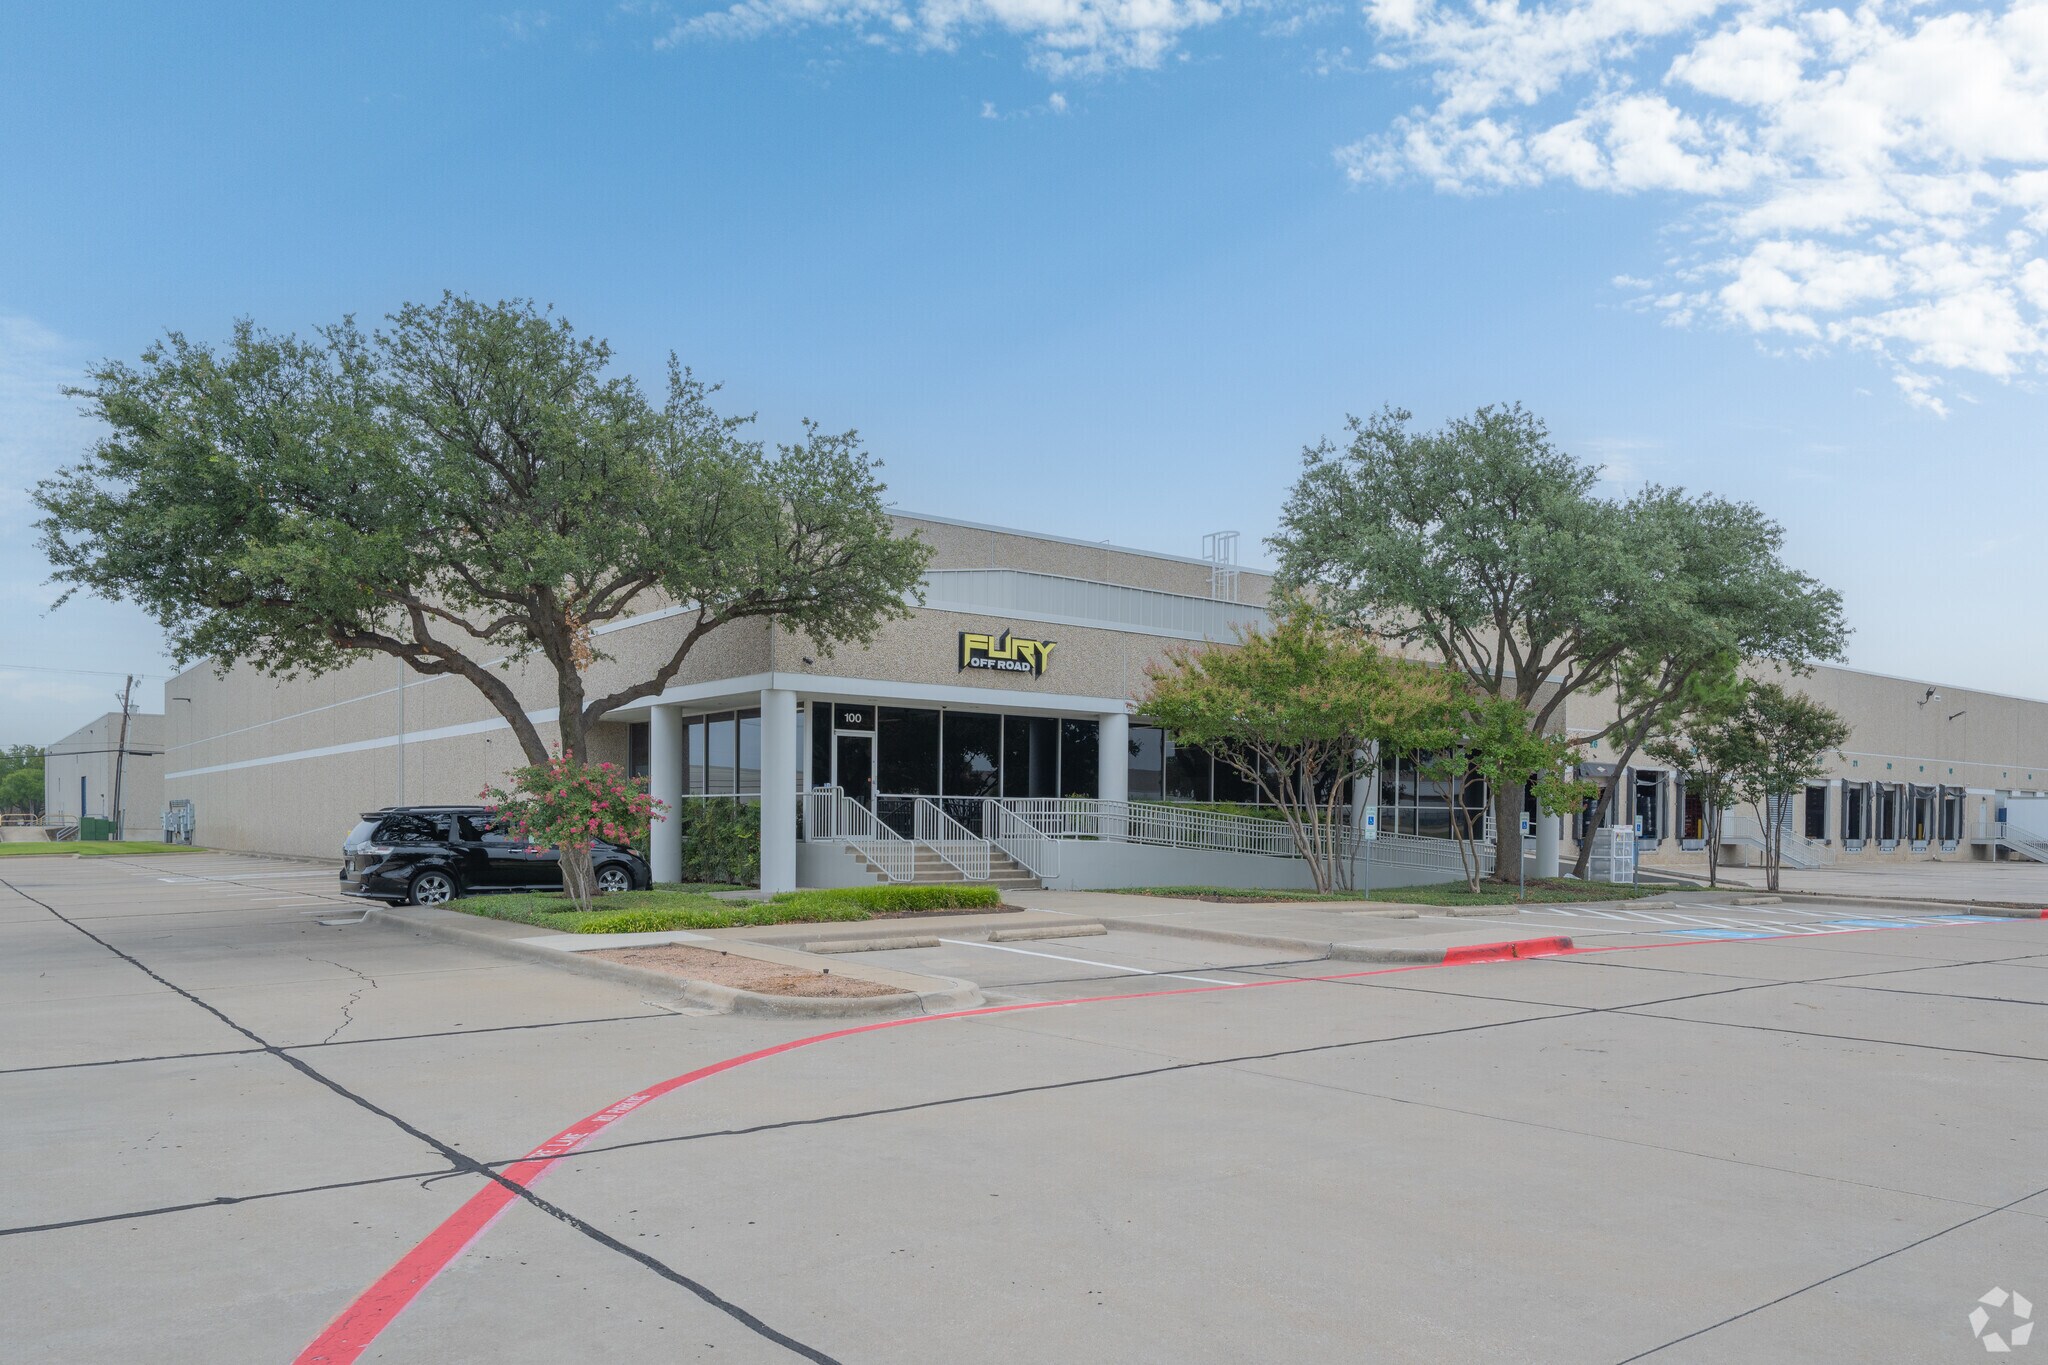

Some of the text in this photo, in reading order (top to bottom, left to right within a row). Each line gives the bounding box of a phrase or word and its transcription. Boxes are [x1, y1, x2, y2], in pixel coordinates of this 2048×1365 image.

[958, 628, 1058, 681] FURY
[970, 657, 1031, 671] OFF ROAD
[844, 713, 862, 723] 100
[521, 1149, 562, 1163] FRE
